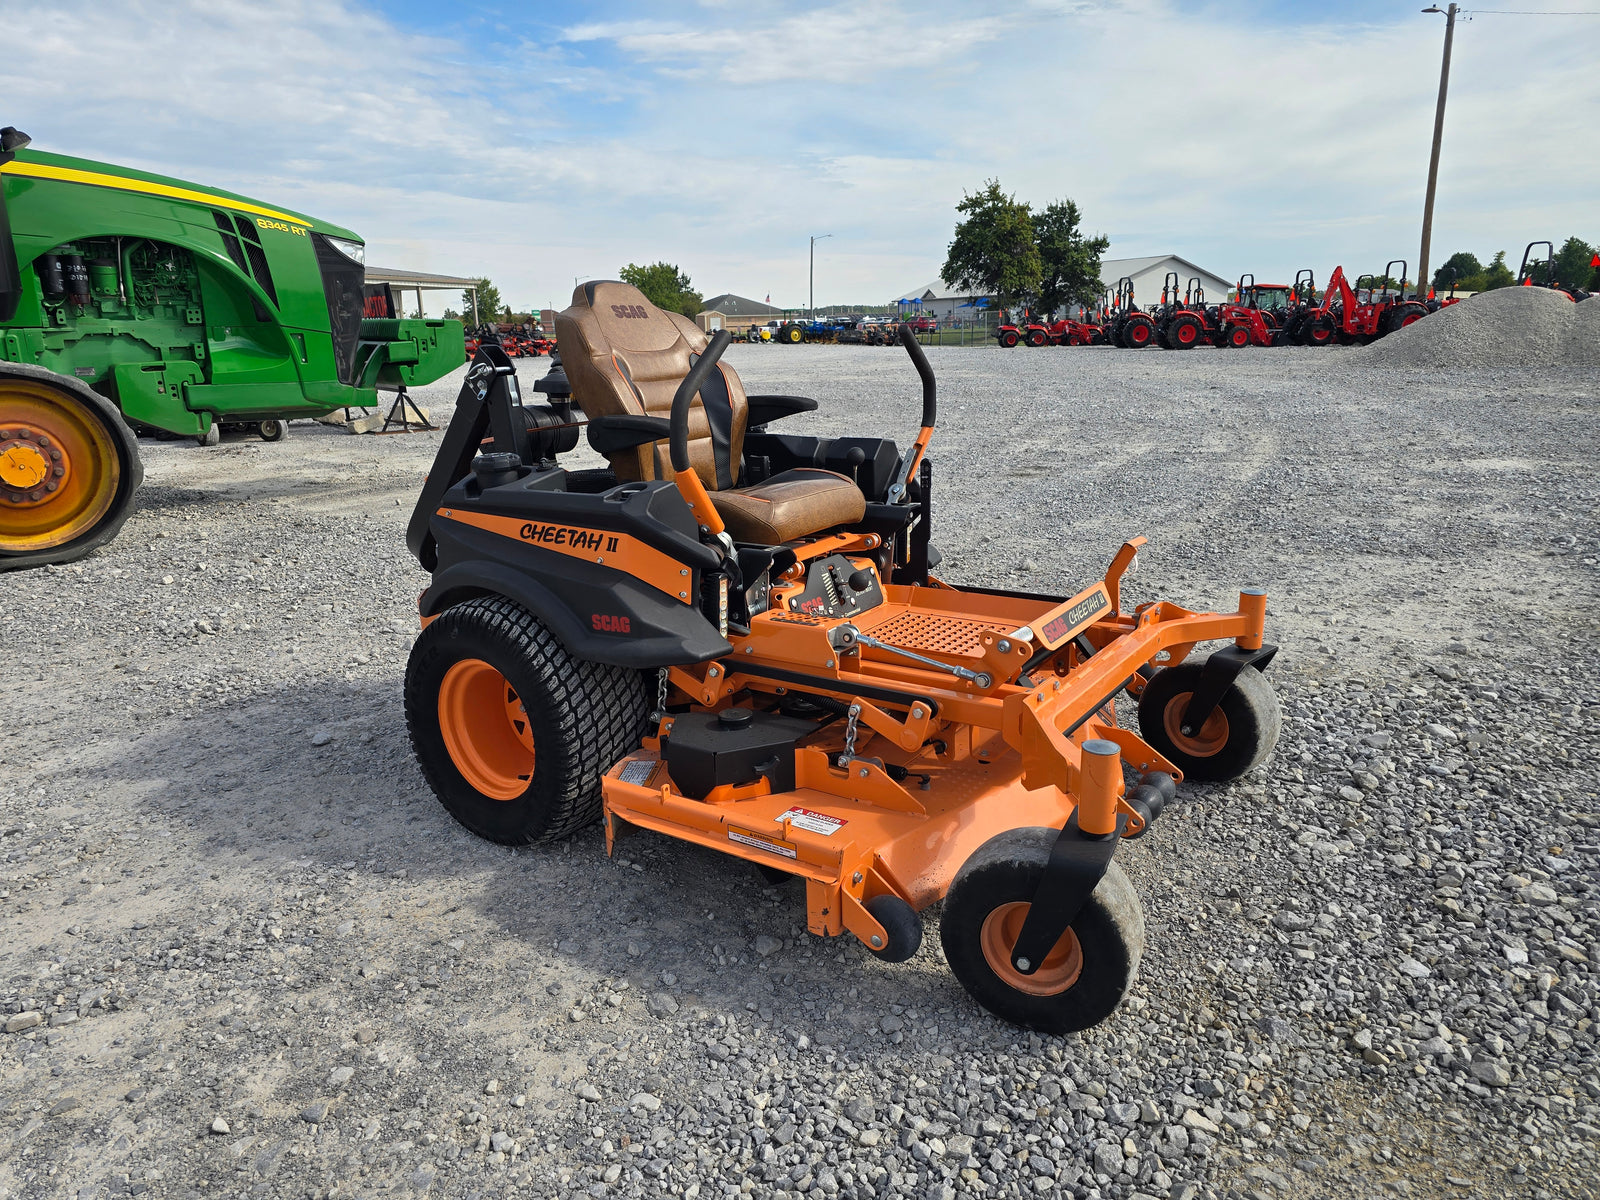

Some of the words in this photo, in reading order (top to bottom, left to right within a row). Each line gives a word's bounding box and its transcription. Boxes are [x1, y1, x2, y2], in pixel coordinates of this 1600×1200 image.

[256, 218, 289, 232] 8345
[290, 225, 306, 236] RT
[362, 295, 387, 318] ACTOR
[610, 304, 649, 319] SCAG
[519, 523, 603, 552] CHEETAH
[606, 537, 619, 552] II
[591, 613, 631, 633] SCAG
[1043, 617, 1068, 642] SCAG
[1068, 594, 1100, 625] CHEETAH
[806, 811, 842, 824] DANGER
